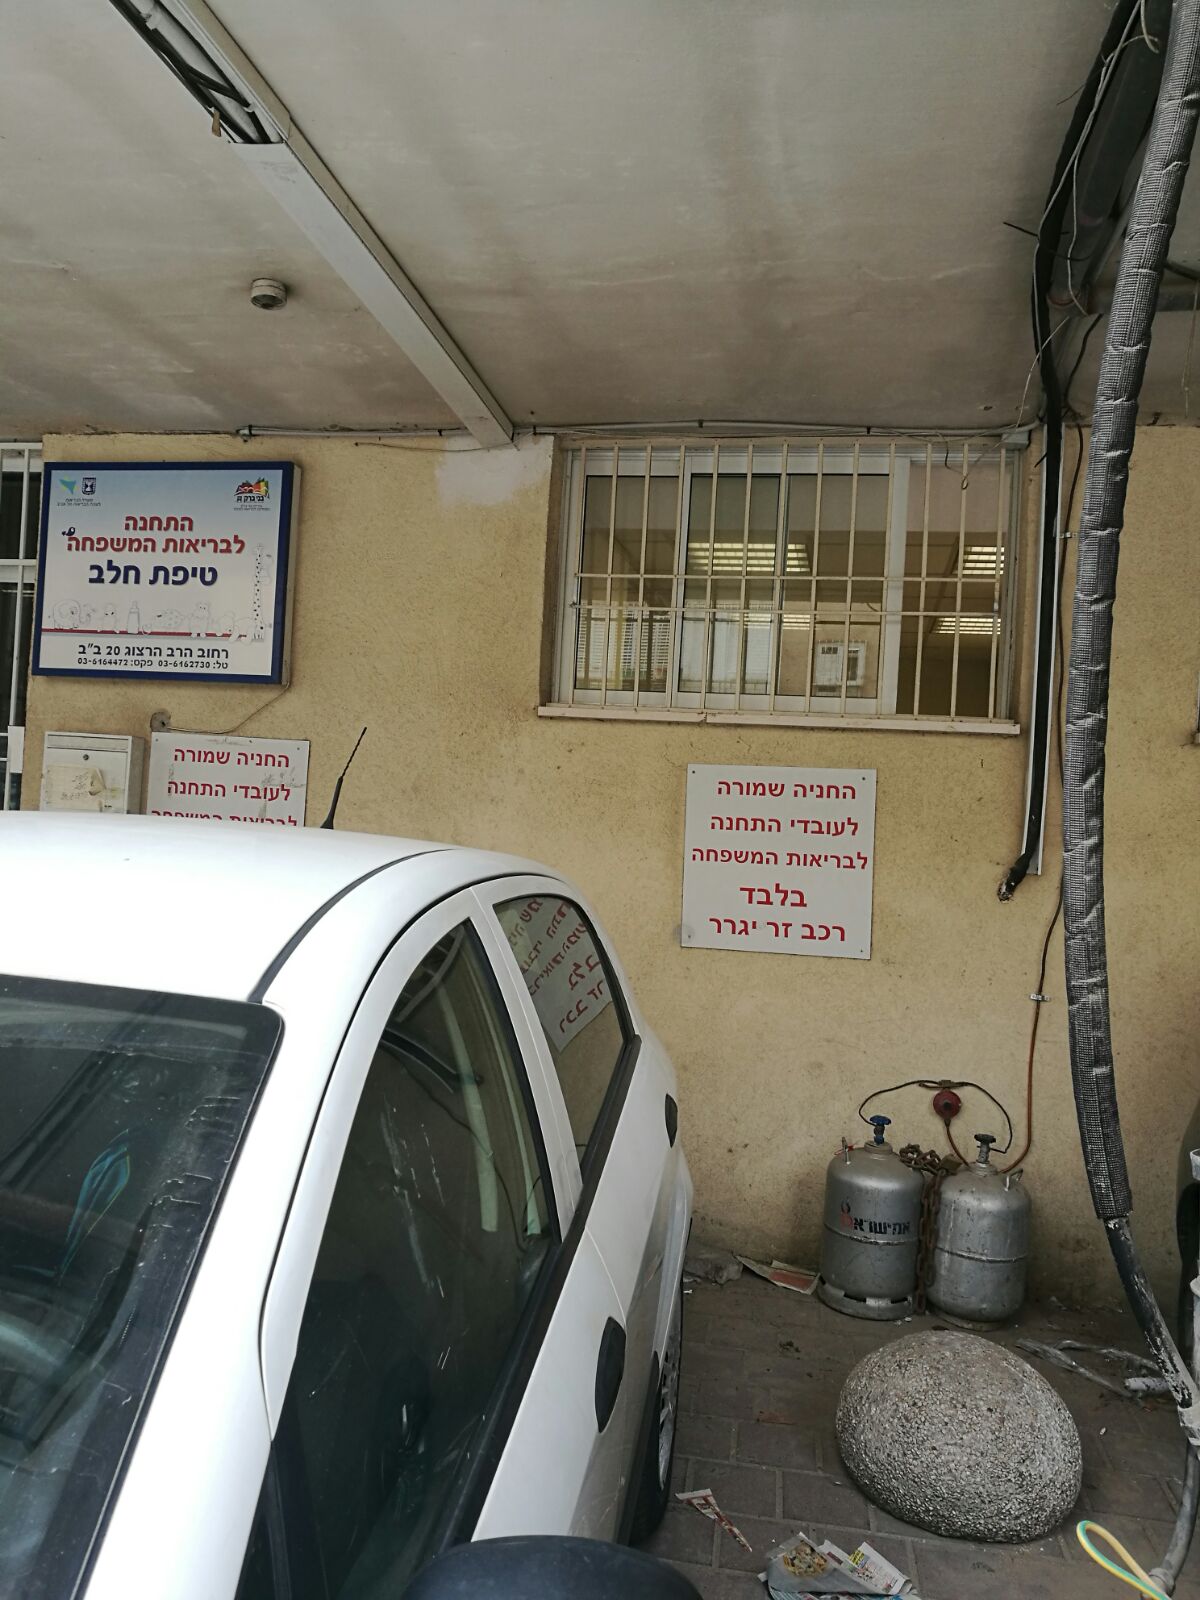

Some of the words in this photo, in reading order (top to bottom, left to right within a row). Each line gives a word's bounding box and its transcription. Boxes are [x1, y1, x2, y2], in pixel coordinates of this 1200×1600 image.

[124, 515, 194, 532] התחנה
[67, 535, 156, 553] המשפחה
[162, 535, 246, 554] לבריאות
[88, 560, 140, 584] חלב
[149, 564, 218, 586] טיפת
[106, 645, 121, 656] 20
[125, 646, 162, 657] הרצוג
[166, 646, 193, 658] הרב
[197, 647, 229, 658] רחוב
[130, 659, 153, 668] פקס:
[158, 660, 210, 669] 03-6162730
[213, 660, 228, 669] טל:
[173, 748, 231, 764] שמורה
[237, 750, 290, 768] החניה
[167, 780, 226, 797] התחנה
[233, 783, 291, 801] לעובדי
[717, 780, 785, 797] שמורה
[793, 783, 856, 800] החניה
[710, 816, 781, 832] התחנה
[790, 817, 859, 836] לעובדי
[692, 848, 778, 865] המשפחה
[786, 852, 868, 870] לבריאות
[740, 883, 808, 908] בלבד
[709, 918, 757, 936] יגרר
[767, 921, 792, 938] זר
[801, 924, 846, 942] רכב
